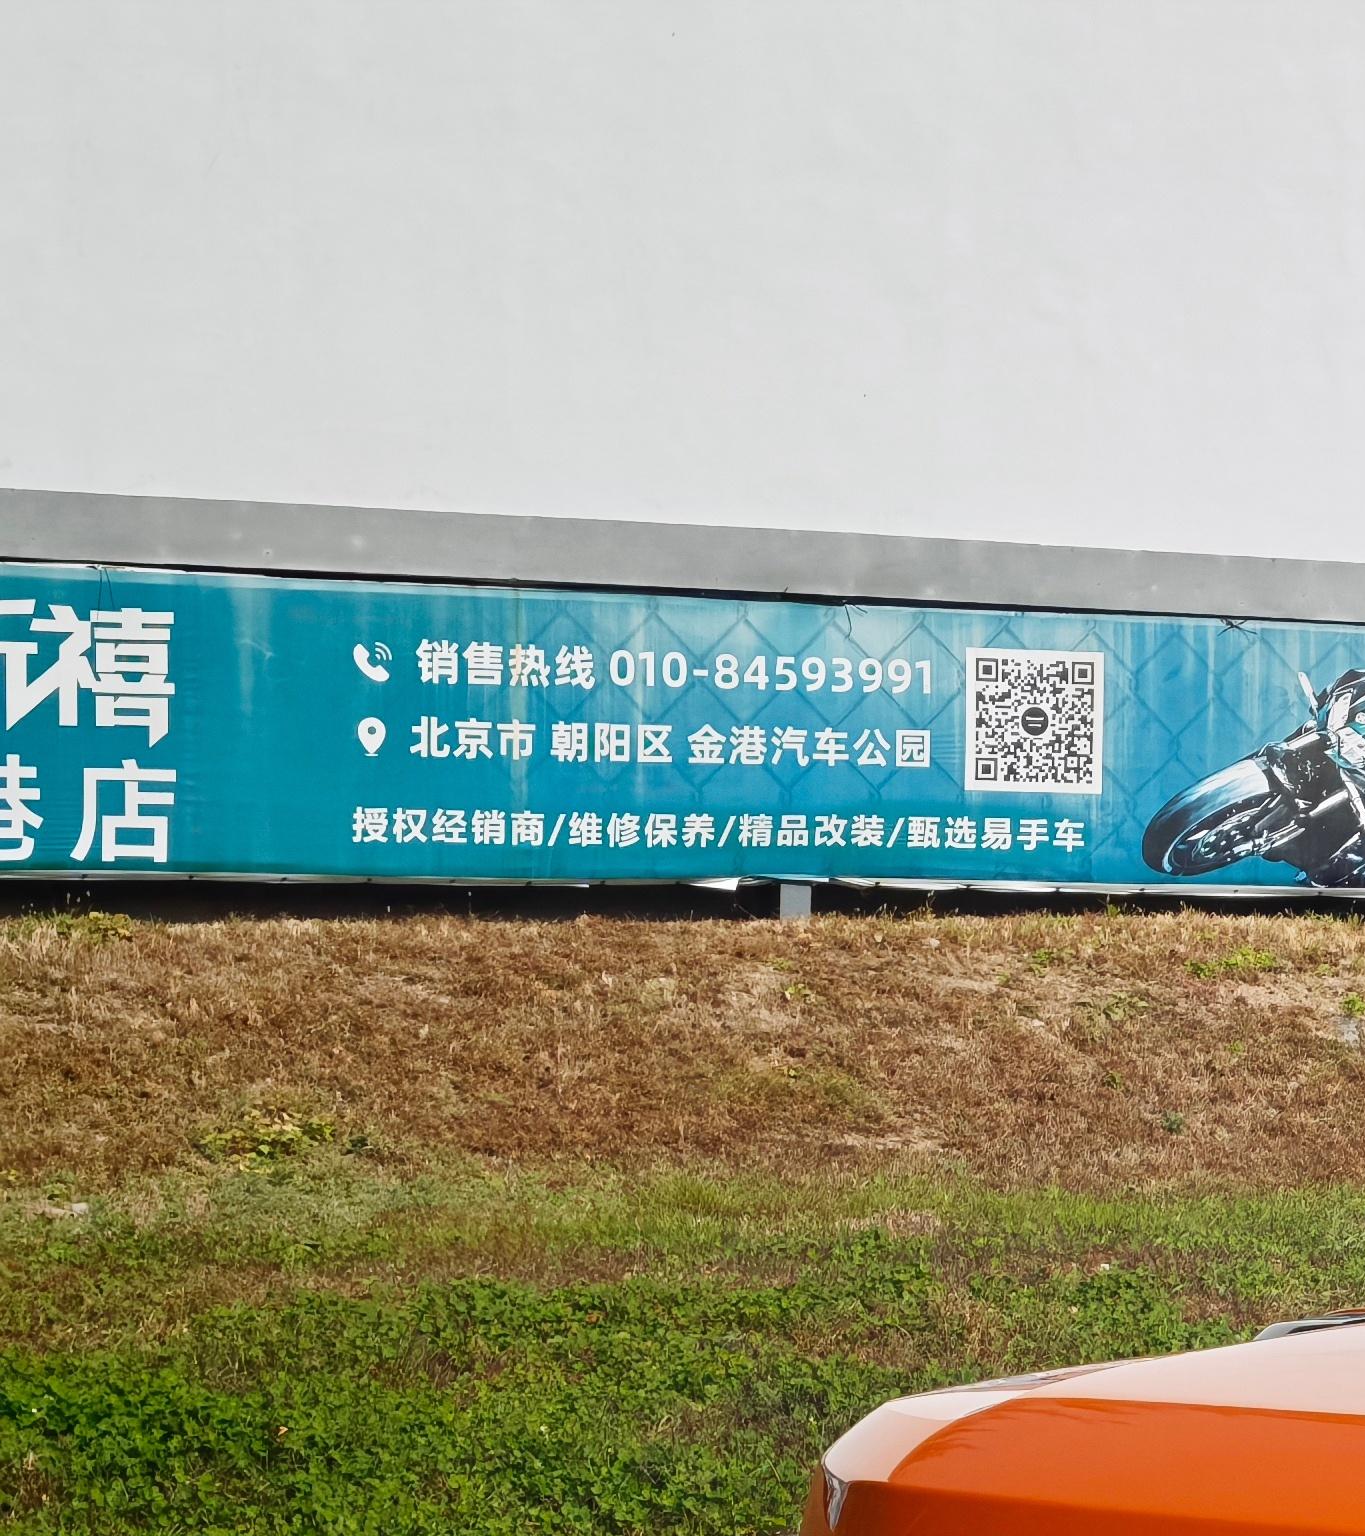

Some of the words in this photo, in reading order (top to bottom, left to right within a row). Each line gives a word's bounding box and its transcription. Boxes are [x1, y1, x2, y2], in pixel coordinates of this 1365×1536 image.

[0, 599, 175, 748] 禧
[415, 638, 596, 690] 销售热线
[609, 648, 932, 694] 010-84593991
[409, 715, 537, 760] 北京市
[550, 720, 673, 764] 朝阳区
[687, 724, 931, 768] 金港汽车公园
